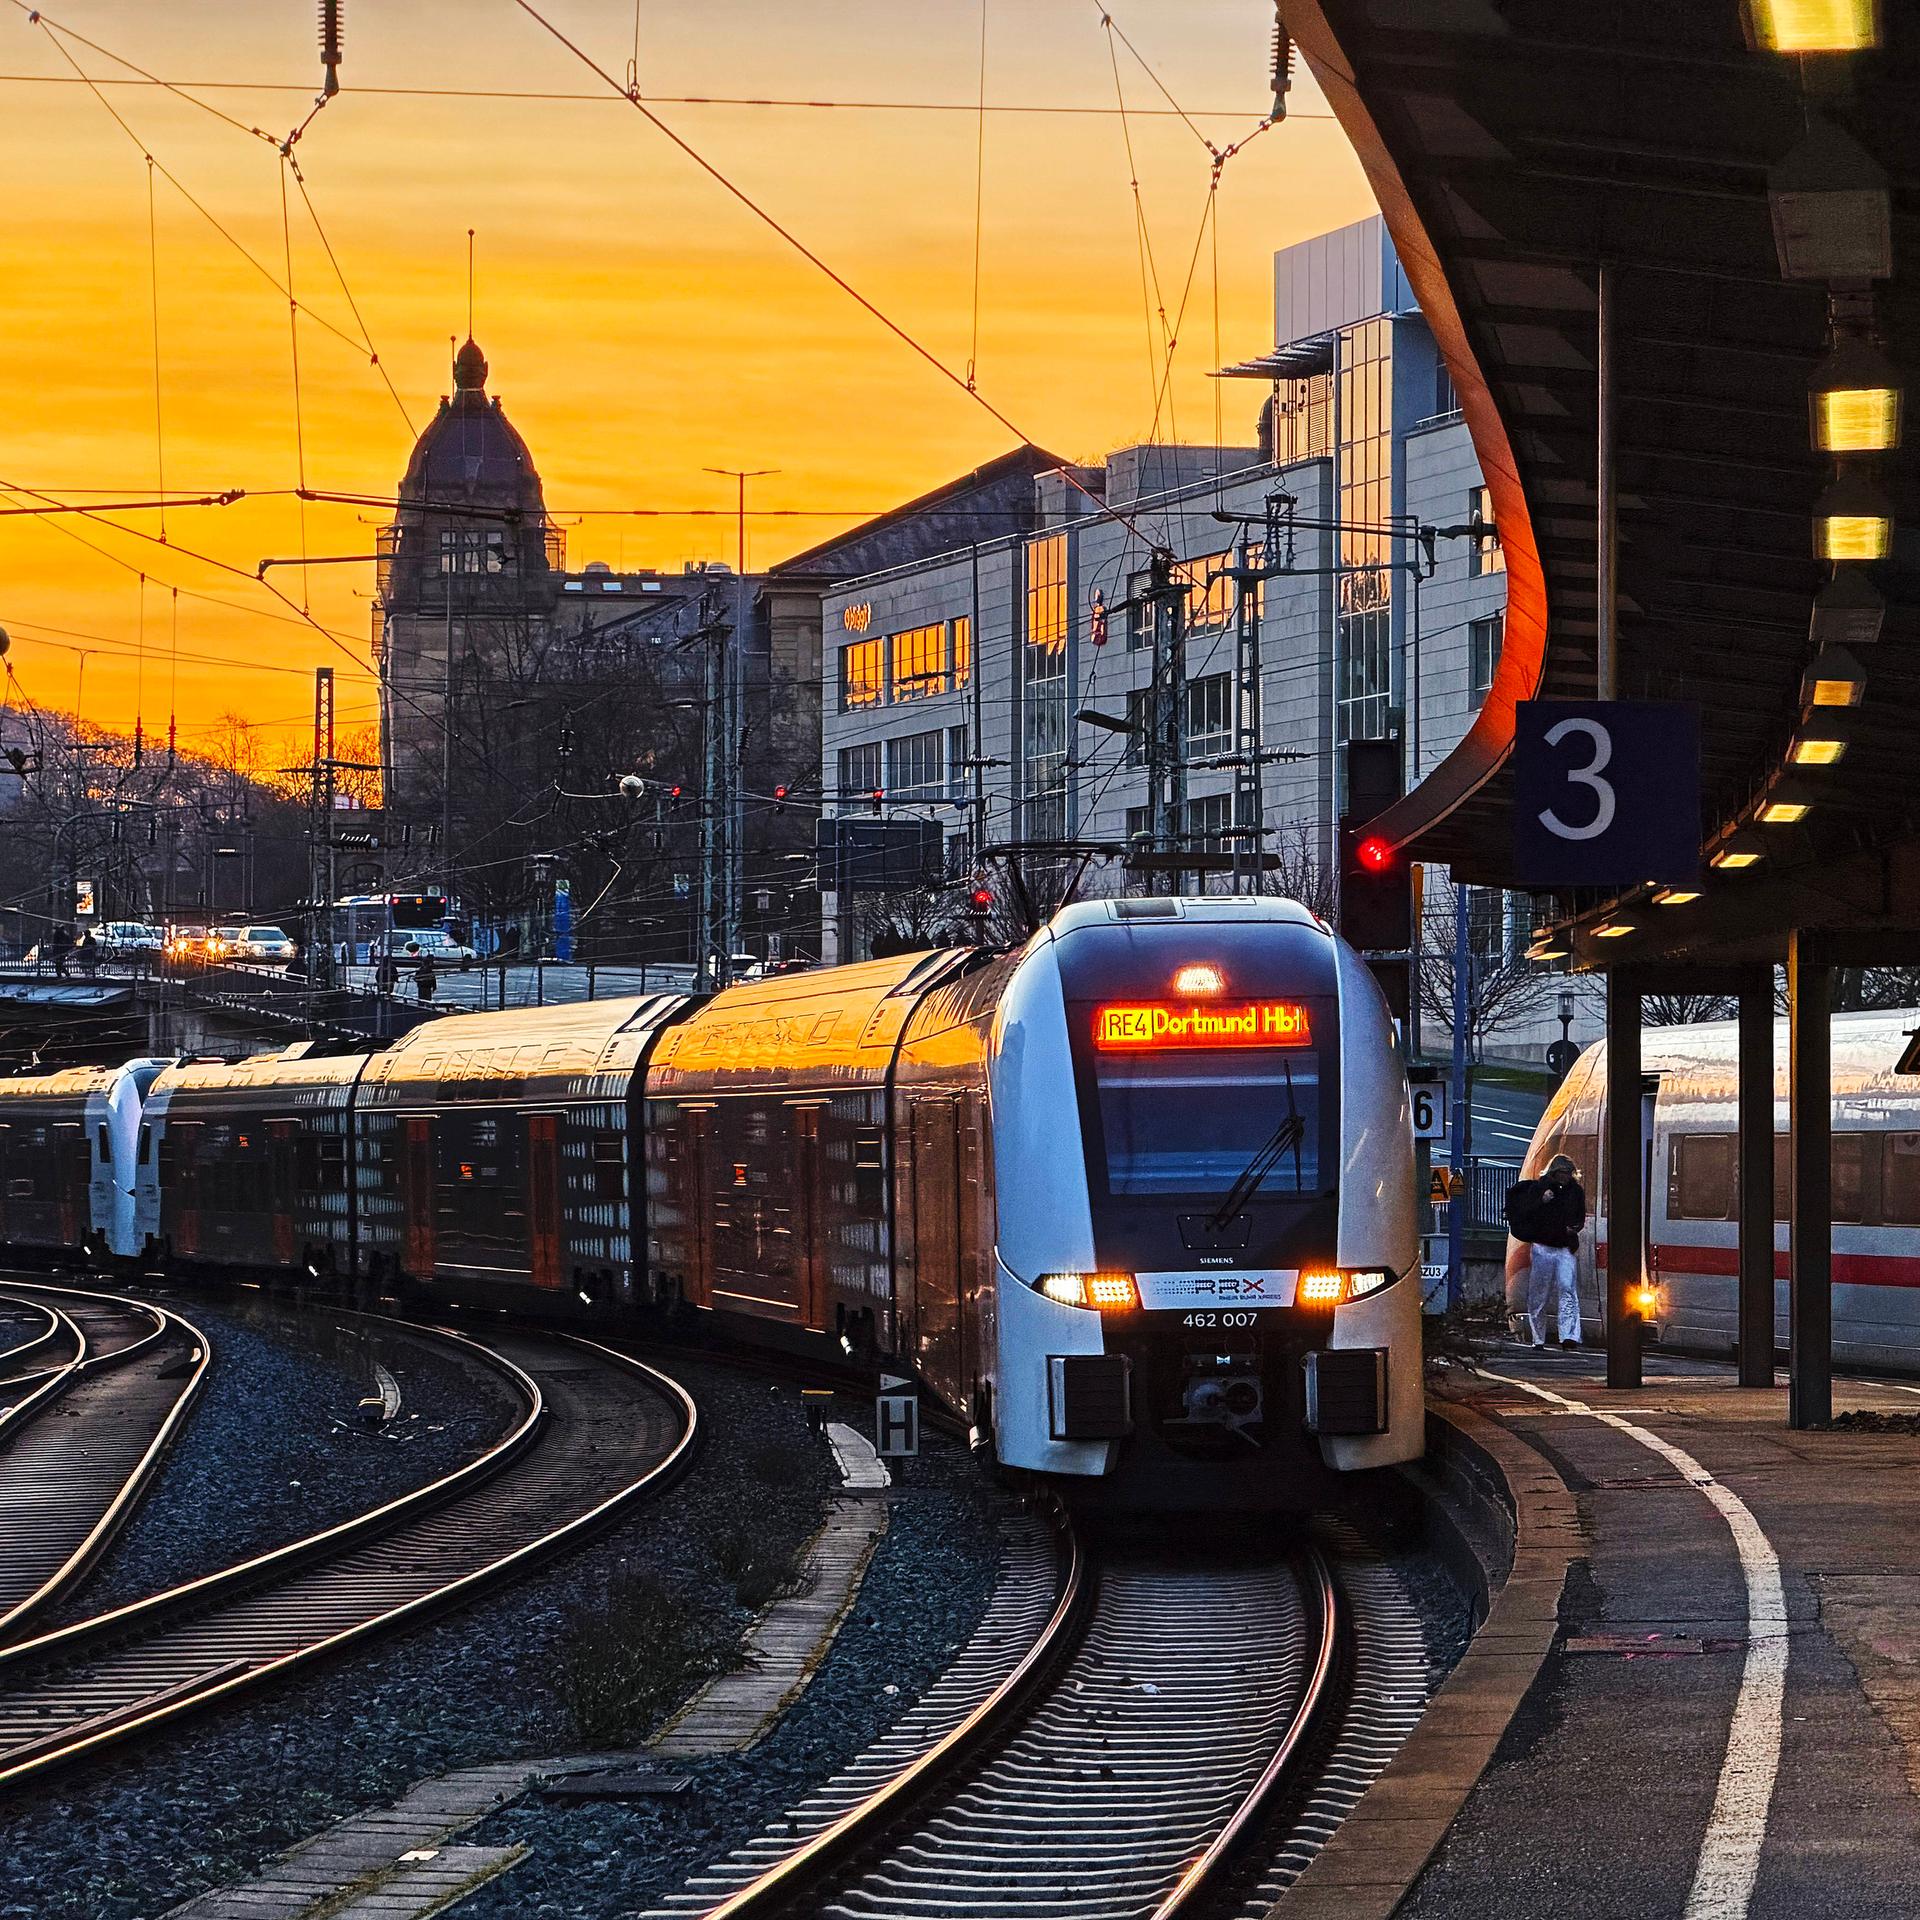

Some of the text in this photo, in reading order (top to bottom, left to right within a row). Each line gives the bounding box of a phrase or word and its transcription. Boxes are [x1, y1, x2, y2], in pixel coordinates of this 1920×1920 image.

[1537, 717, 1616, 841] 3
[1108, 1012, 1147, 1037] RE4
[1152, 1008, 1257, 1034] Dortmund
[1413, 1090, 1433, 1131] 6
[1199, 1257, 1234, 1265] SIEMENS
[1194, 1278, 1265, 1295] RRX
[1182, 1312, 1258, 1328] 462 007
[881, 1400, 914, 1451] H
